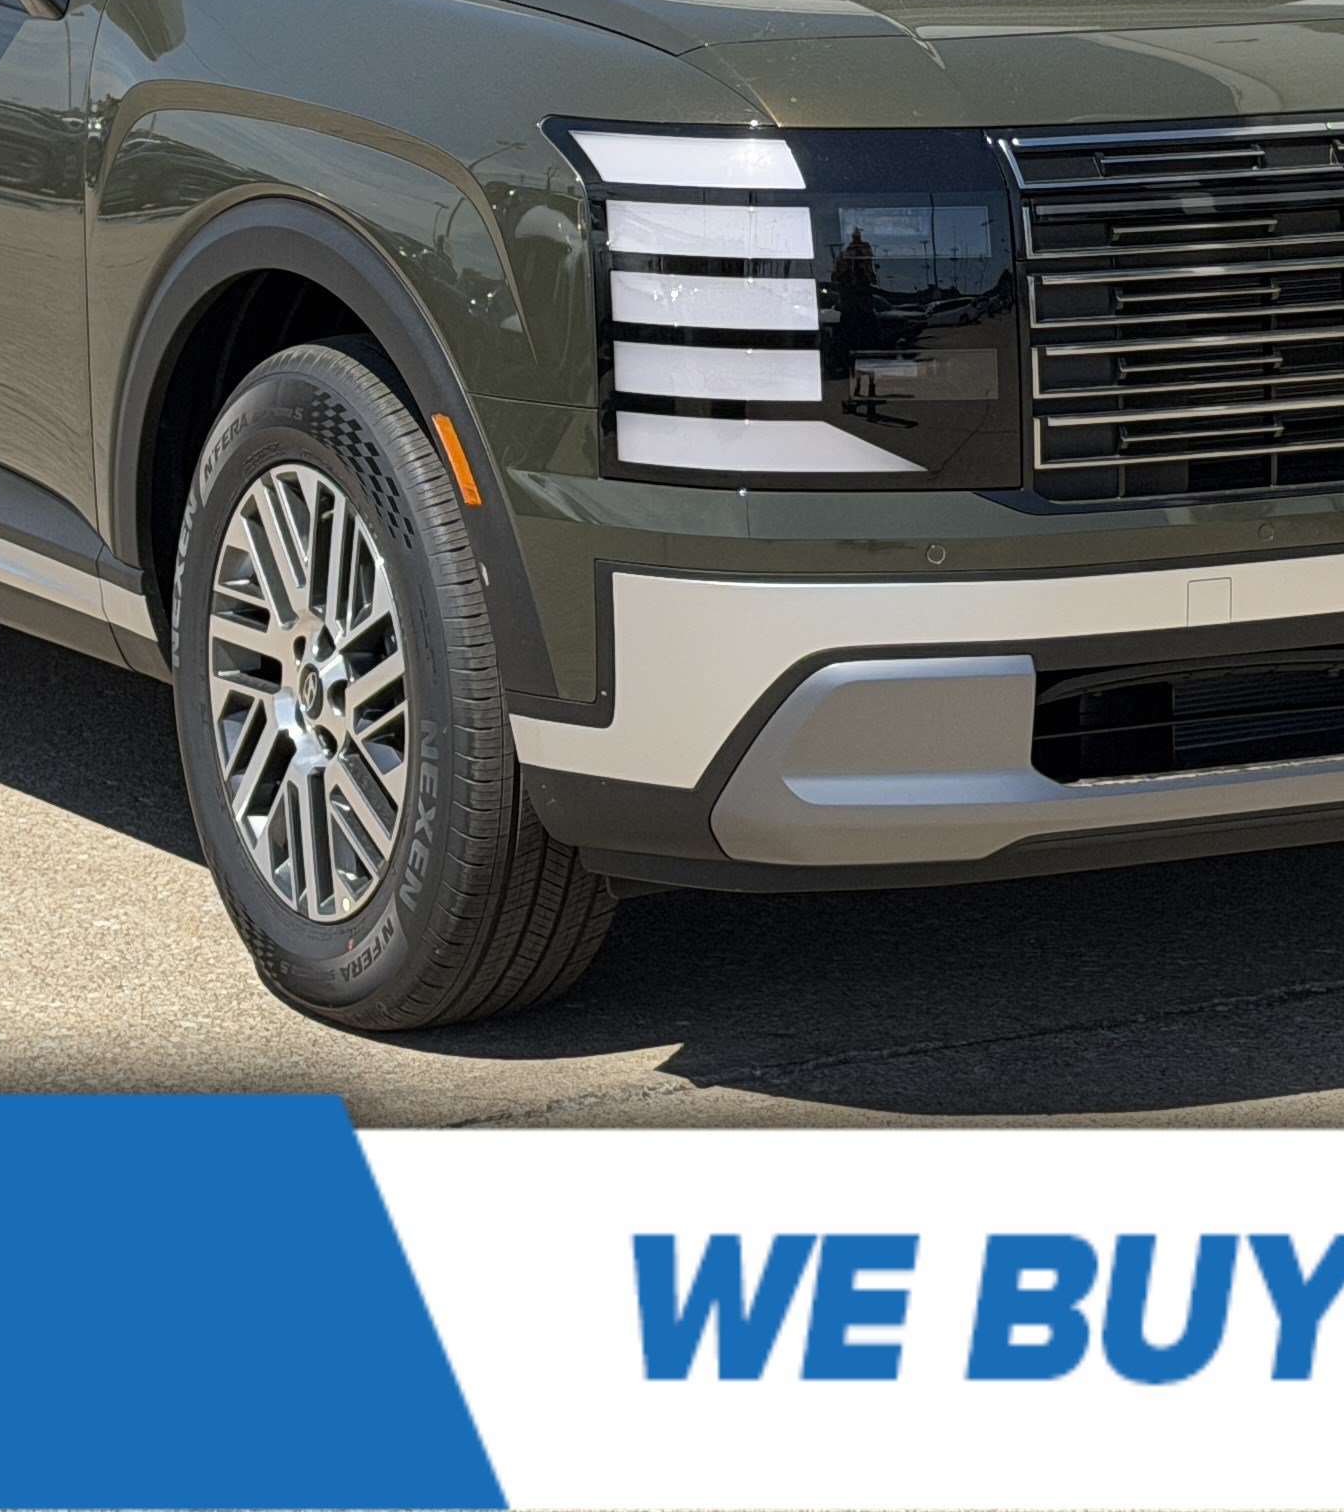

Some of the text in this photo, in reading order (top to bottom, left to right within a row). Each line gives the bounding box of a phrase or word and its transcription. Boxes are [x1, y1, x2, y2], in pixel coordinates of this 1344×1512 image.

[171, 493, 198, 668] NEXEN
[399, 720, 439, 912] NEXEN
[339, 917, 395, 983] N'FERA
